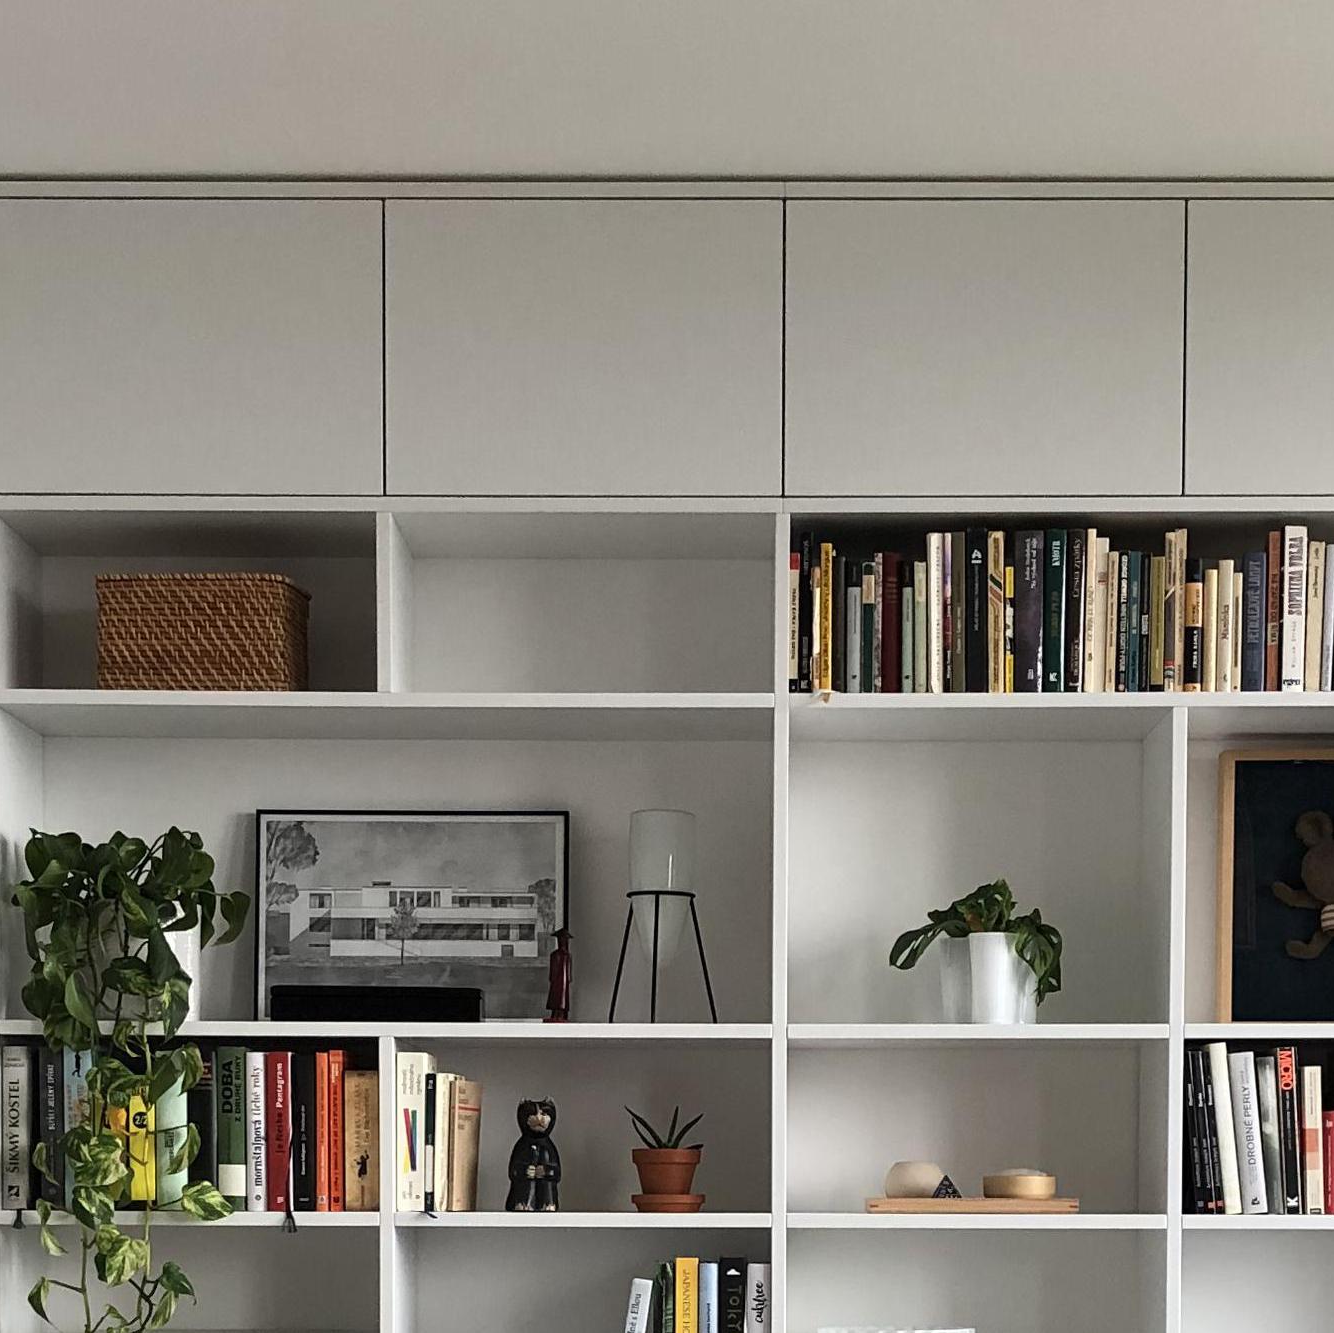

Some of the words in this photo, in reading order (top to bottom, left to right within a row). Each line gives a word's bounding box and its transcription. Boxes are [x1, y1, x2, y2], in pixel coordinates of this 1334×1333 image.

[1052, 540, 1061, 567] KMOTR
[1072, 537, 1082, 569] zpátky
[1287, 536, 1304, 568] VOLBA
[1246, 560, 1261, 587] LAMPY
[1287, 569, 1304, 616] SOPHIINA
[1246, 590, 1261, 644] PETROLEJOVÉ
[221, 1059, 234, 1114] DOBA
[233, 1056, 242, 1081] RUKY
[250, 1067, 263, 1088] roky
[275, 1062, 285, 1108] Pentagram
[1278, 1051, 1294, 1090] MICRO
[7, 1078, 20, 1128] KOSTEL
[47, 1086, 56, 1108] JELENY
[233, 1083, 242, 1114] DRUHÉ
[251, 1091, 261, 1116] tiché
[1242, 1085, 1253, 1118] PERLY
[5, 1131, 20, 1173] ŠIKMÝ
[250, 1120, 265, 1187] mornštajnová
[1243, 1120, 1257, 1165] DROBNÉ
[630, 1293, 642, 1315] Ellou
[682, 1268, 691, 1318] JAPANESE
[750, 1281, 768, 1324] cukrfree
